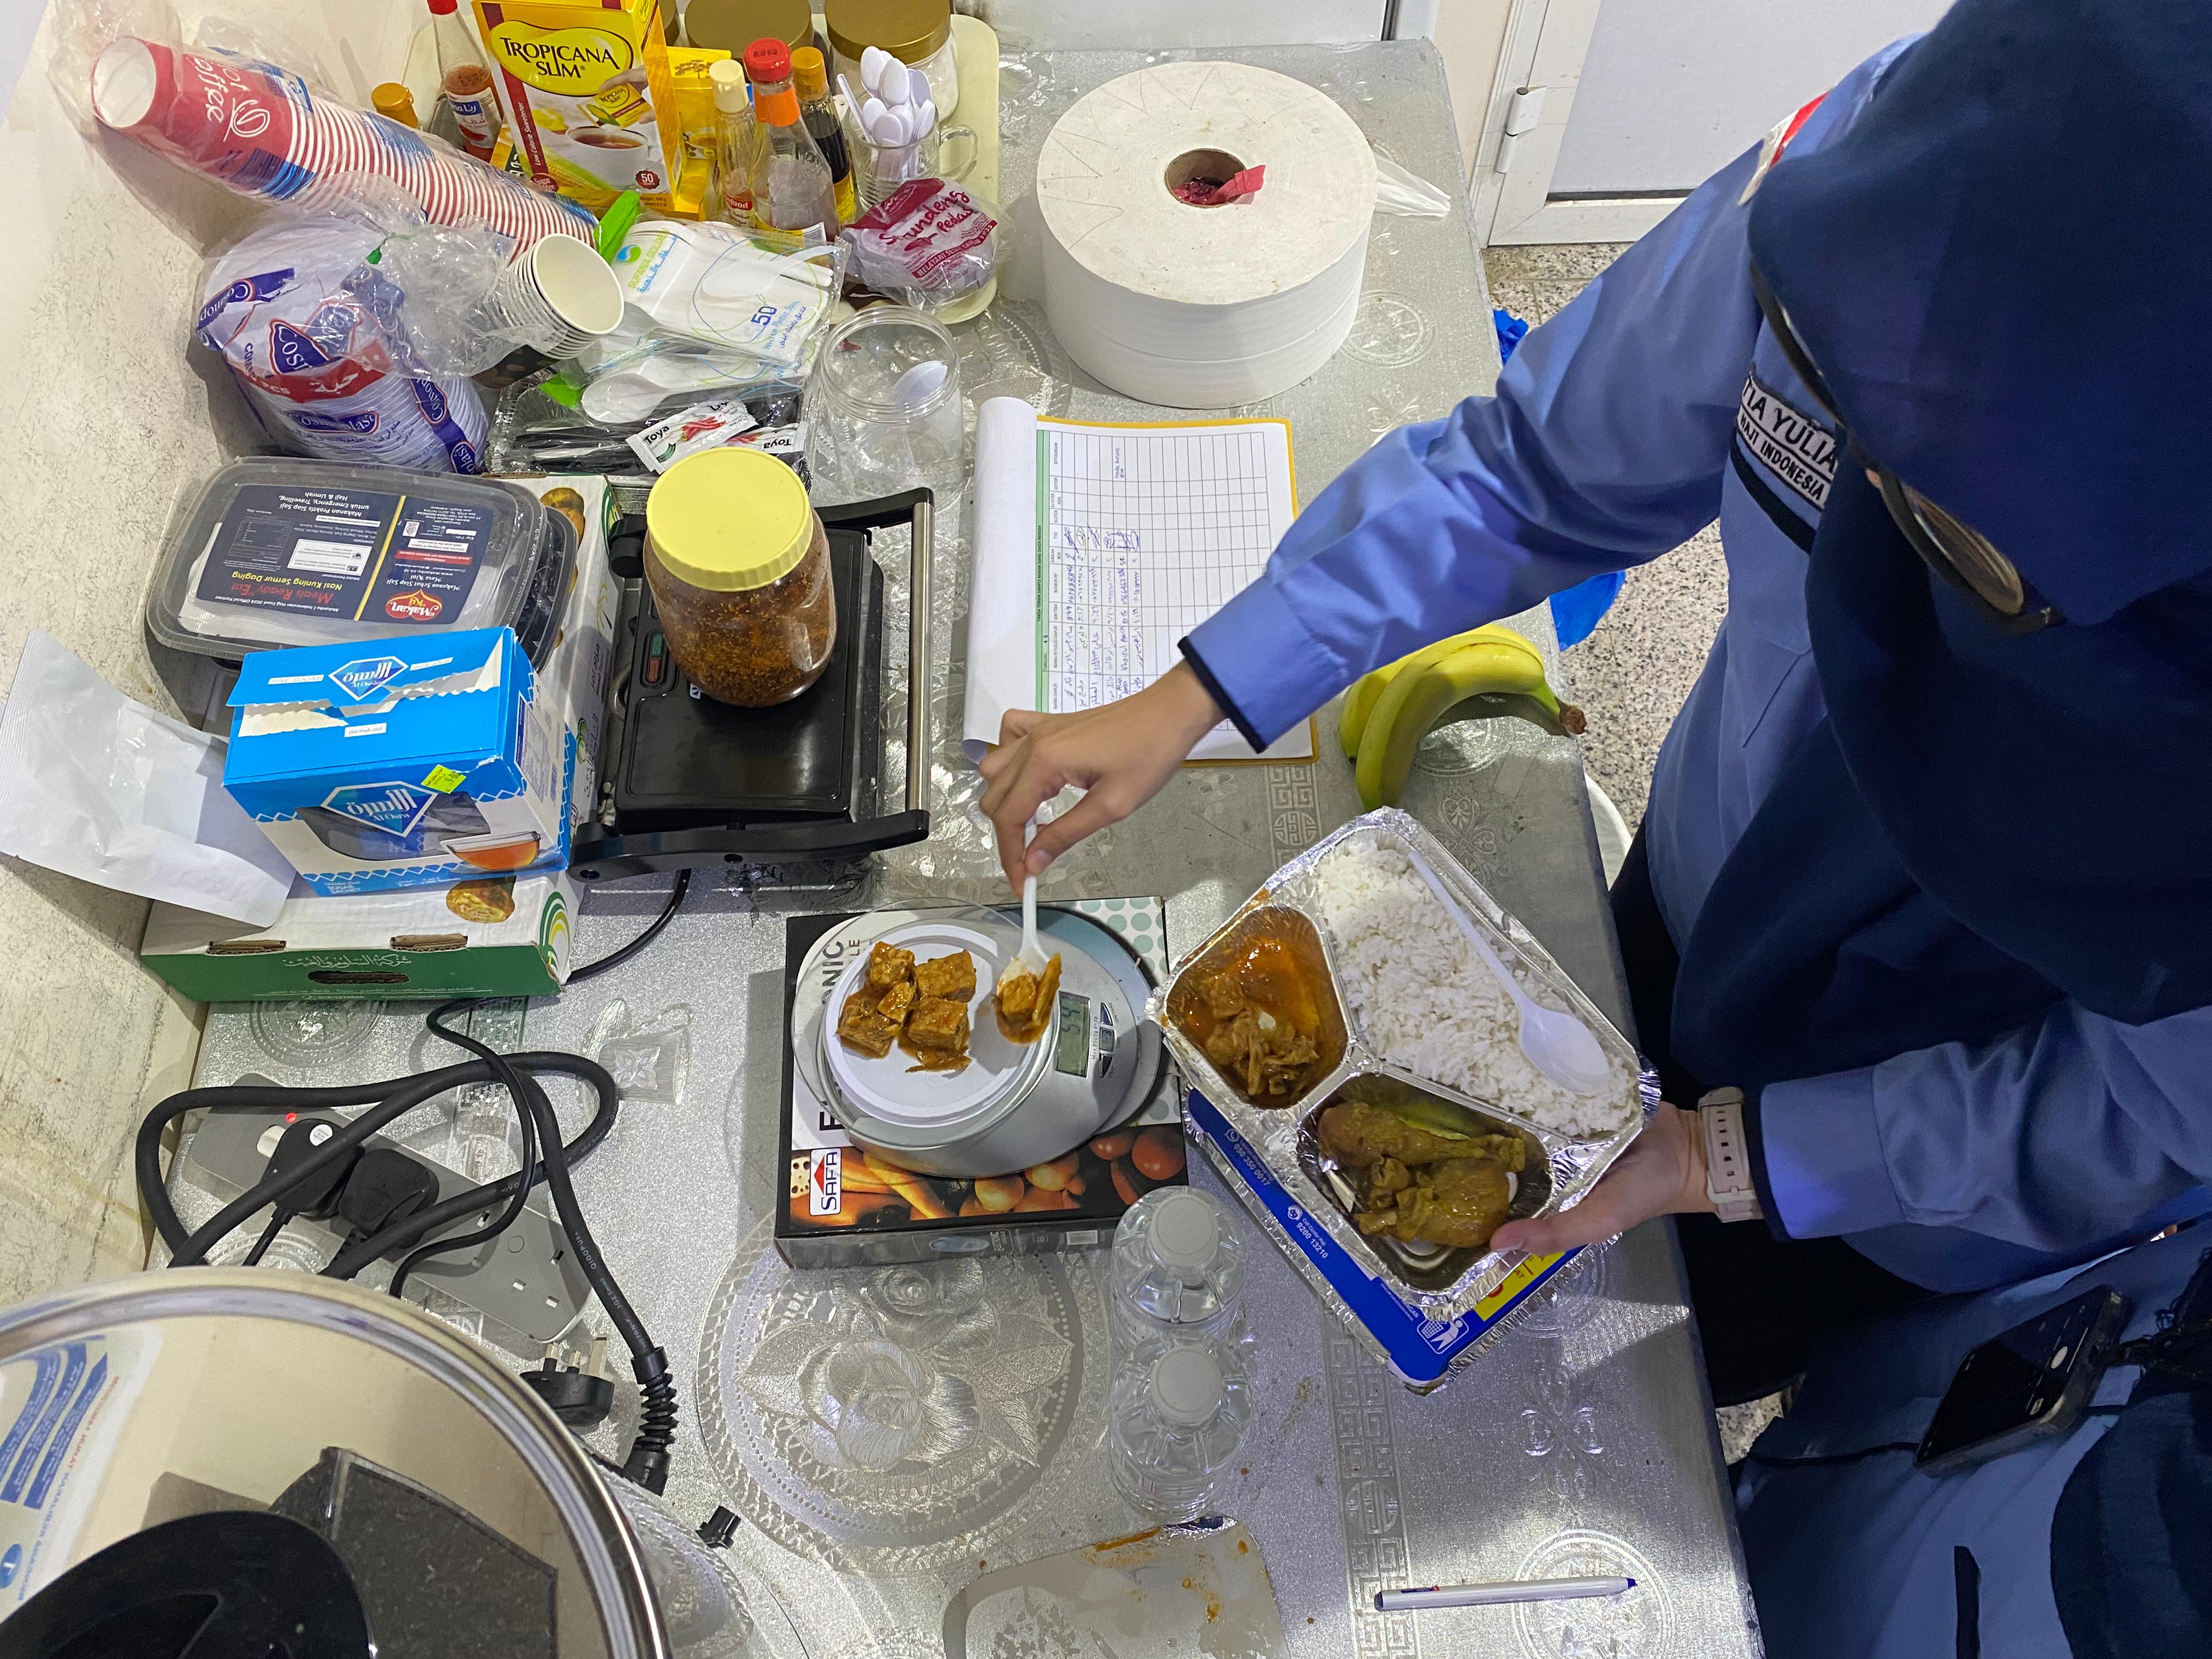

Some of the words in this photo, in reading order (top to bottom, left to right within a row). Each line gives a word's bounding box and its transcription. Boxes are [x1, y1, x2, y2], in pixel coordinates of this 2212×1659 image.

[500, 37, 619, 70] TROPICANA
[537, 60, 582, 78] SLIM
[517, 100, 532, 134] Sweetener
[526, 132, 538, 154] Calorie
[532, 153, 541, 166] Low
[641, 173, 653, 183] 50
[935, 206, 974, 233] Pedas
[977, 223, 994, 240] 1935
[628, 258, 652, 289] SUFANA
[751, 306, 777, 327] 50
[644, 425, 670, 446] Toya
[763, 439, 792, 450] Toya
[1773, 407, 1836, 473] YULIA
[1760, 439, 1825, 500] INDONESIA
[278, 495, 310, 504] Travelling,
[312, 498, 348, 507] Emergency,
[331, 509, 361, 517] Makanan
[231, 571, 262, 582] Daging
[264, 575, 291, 585] Semur
[292, 578, 320, 588] Kuning
[257, 584, 293, 600] Ready
[296, 589, 333, 604] Meals
[390, 601, 438, 616] Makan
[342, 660, 391, 685] الأسرة
[347, 787, 417, 816] الأسرة
[373, 814, 387, 822] Al
[388, 812, 410, 821] Osra
[1232, 1143, 1246, 1158] 050
[1243, 1156, 1256, 1170] 350
[1253, 1168, 1270, 1187] 0017
[821, 1151, 839, 1210] SAFA
[1301, 1217, 1310, 1227] Call
[1308, 1225, 1321, 1239] Center
[1295, 1221, 1312, 1239] 9200
[1309, 1237, 1329, 1259] 13210
